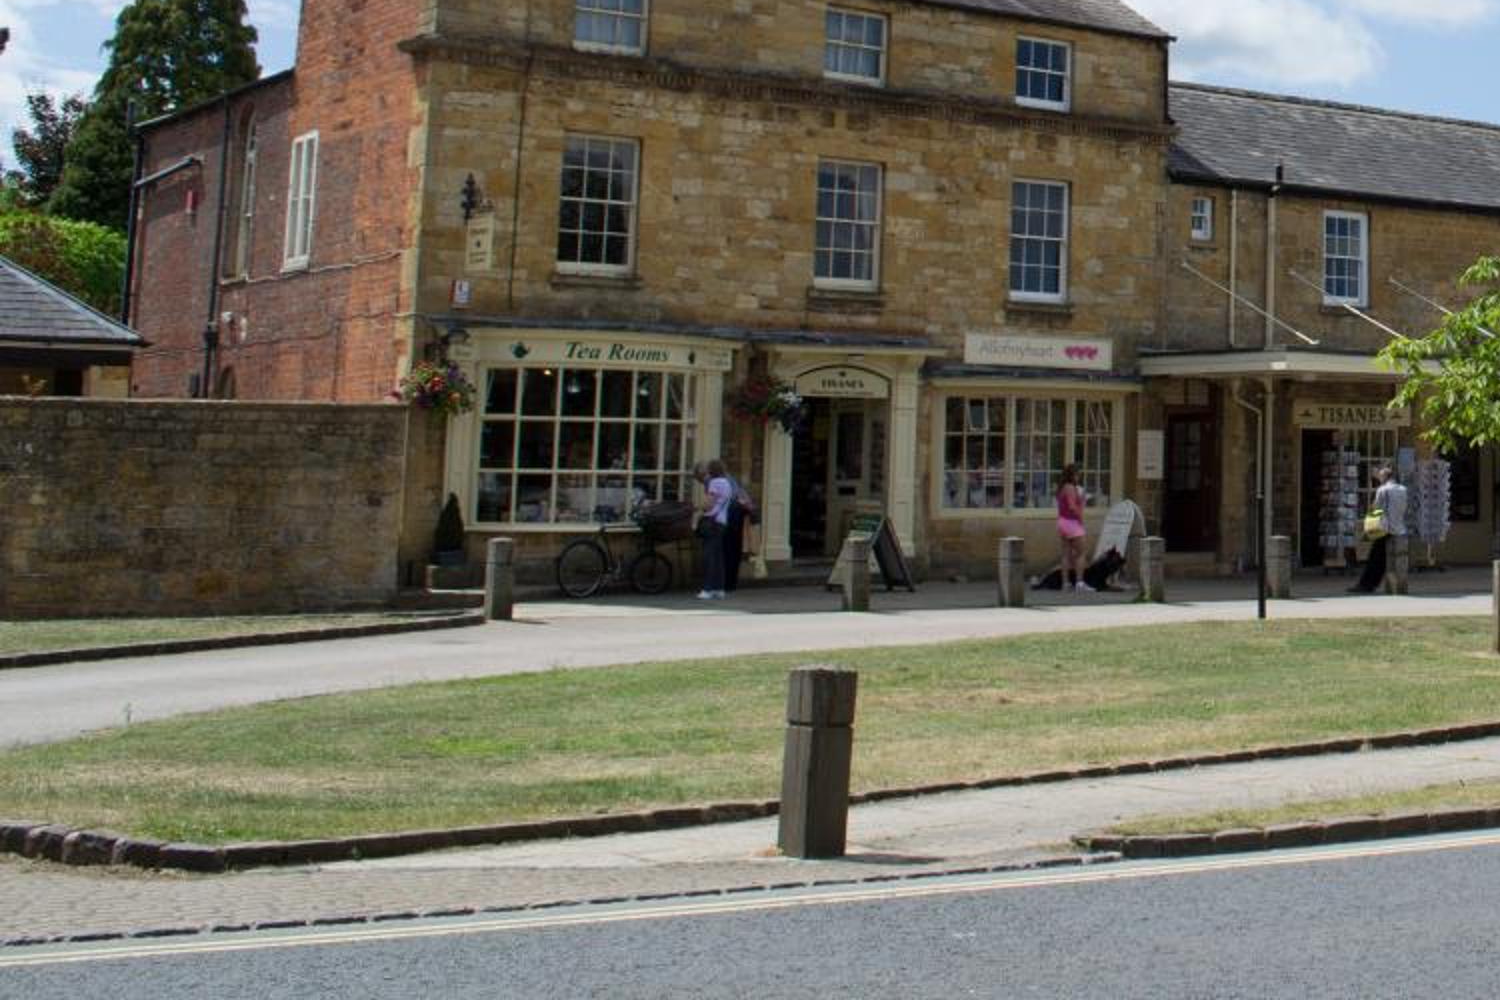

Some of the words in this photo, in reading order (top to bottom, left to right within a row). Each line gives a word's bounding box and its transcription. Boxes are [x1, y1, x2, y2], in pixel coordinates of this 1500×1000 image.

[564, 341, 600, 360] Tea
[607, 343, 670, 362] Rooms
[1318, 407, 1386, 424] TISANES
